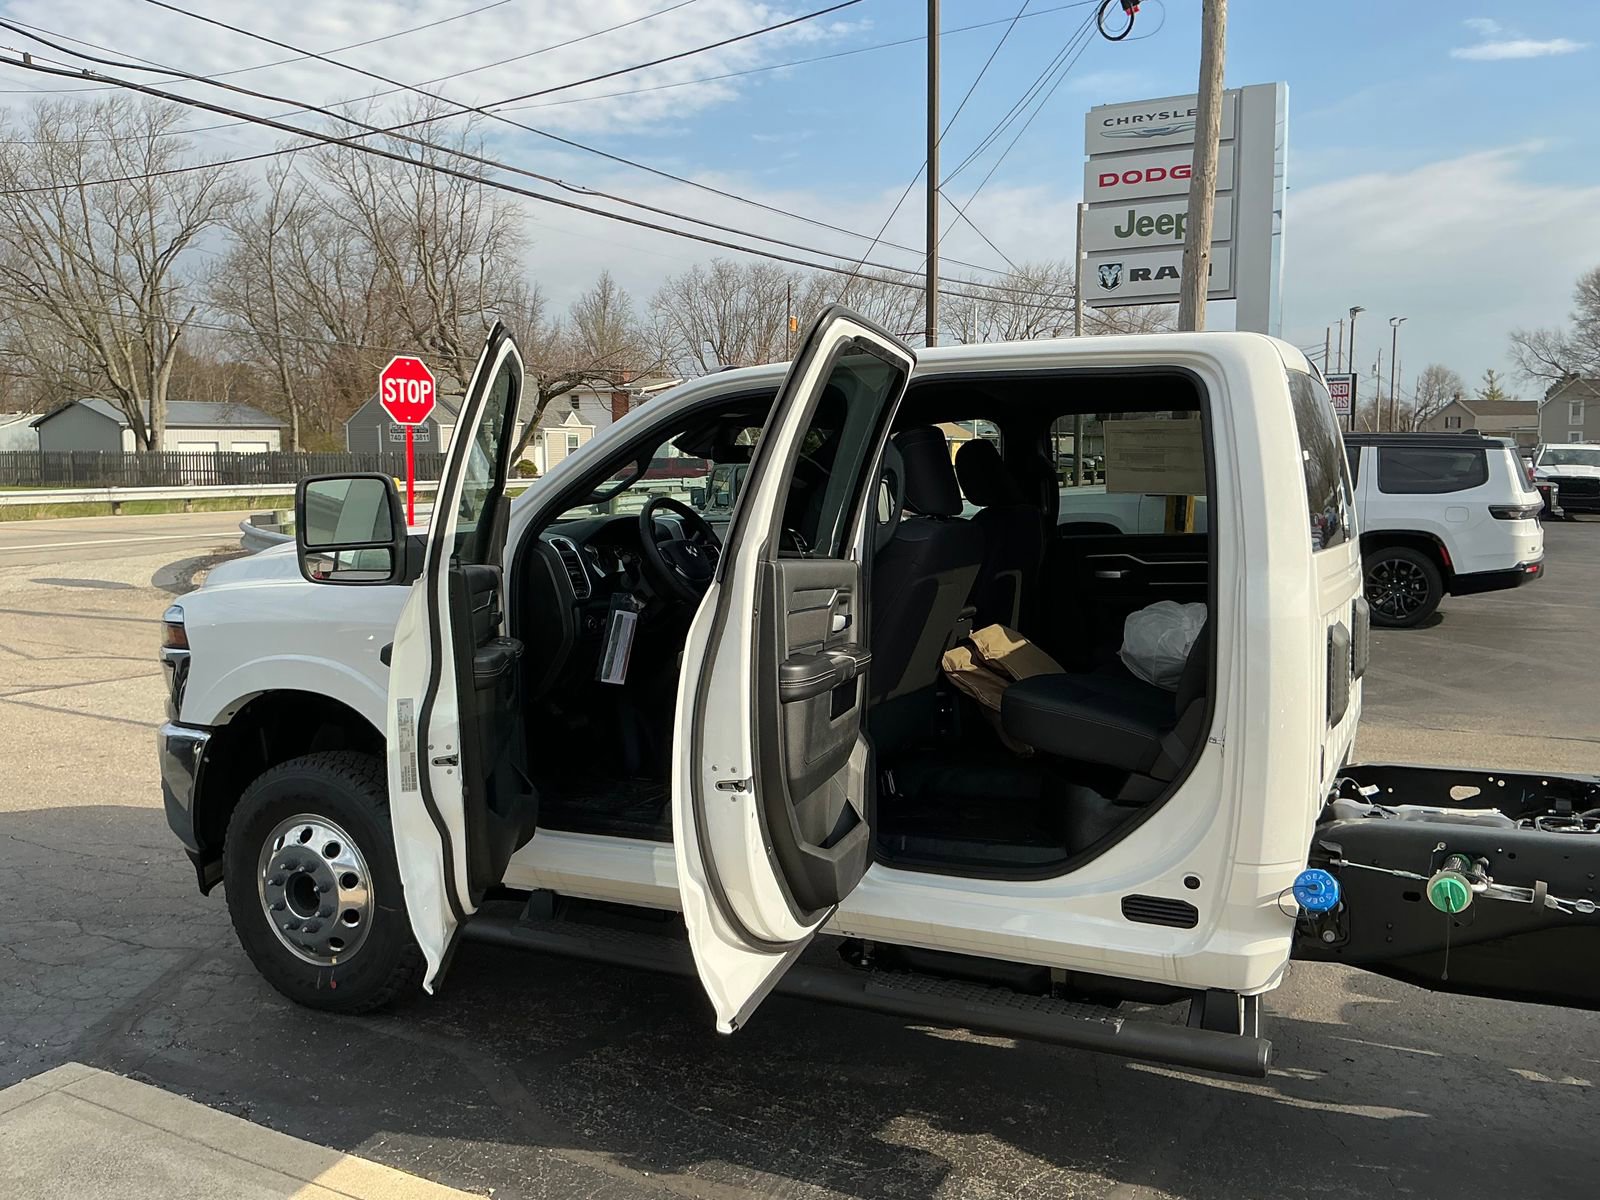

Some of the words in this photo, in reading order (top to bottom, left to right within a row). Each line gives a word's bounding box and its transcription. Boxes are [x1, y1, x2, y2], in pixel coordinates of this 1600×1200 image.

[1103, 108, 1198, 127] CHRYSLE
[1098, 164, 1192, 188] DODG
[1129, 263, 1213, 282] RA
[384, 377, 432, 404] STOP
[1332, 396, 1349, 408] ARS
[1305, 873, 1325, 881] DEF
[1305, 896, 1325, 905] DEF
